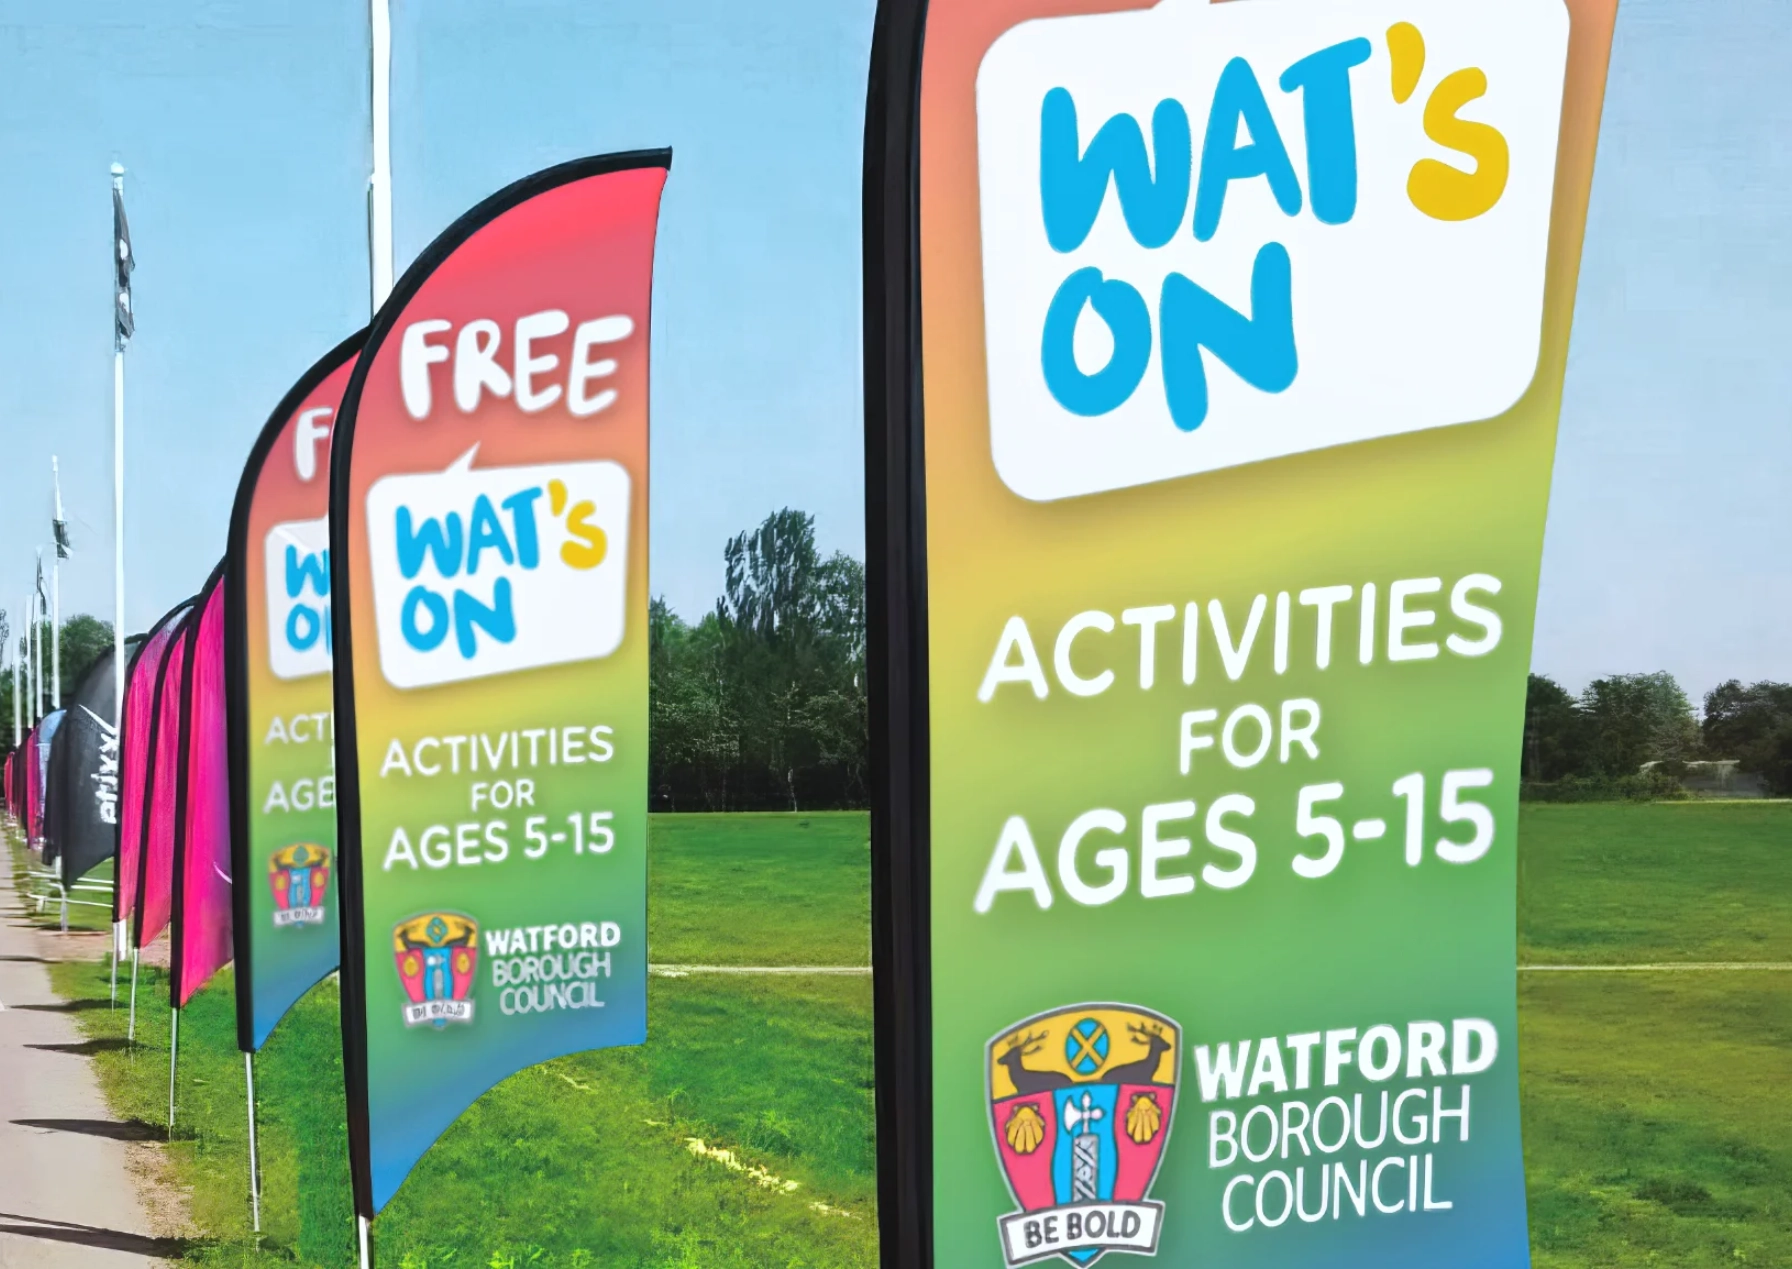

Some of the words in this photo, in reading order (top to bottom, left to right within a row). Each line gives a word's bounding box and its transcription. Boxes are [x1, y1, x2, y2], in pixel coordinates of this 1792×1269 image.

[1039, 21, 1510, 254] WAT'S
[399, 309, 636, 422] FREE
[1040, 241, 1299, 433] ON
[395, 478, 608, 581] WAT'S
[285, 603, 332, 656] O
[400, 576, 517, 660] ON
[976, 572, 1504, 704] ACTIVITIES
[263, 711, 335, 746] ACT
[379, 724, 615, 779] ACTIVITIES
[1178, 696, 1323, 777] FOR
[262, 775, 336, 816] AGE
[470, 777, 537, 813] FOR
[381, 818, 511, 872] AGES
[523, 810, 616, 860] 5-15
[972, 791, 1259, 915] AGES
[1289, 766, 1497, 880] 5-15
[484, 920, 622, 957] WATFORD
[491, 951, 612, 988] BOROUGH
[499, 980, 606, 1016] COUNCIL
[1193, 1017, 1499, 1102] WATFORD
[1207, 1084, 1471, 1168] BOROUGH
[1023, 1215, 1060, 1248] BE
[1066, 1209, 1142, 1241] BOLD
[1222, 1153, 1453, 1232] COUNCIL
